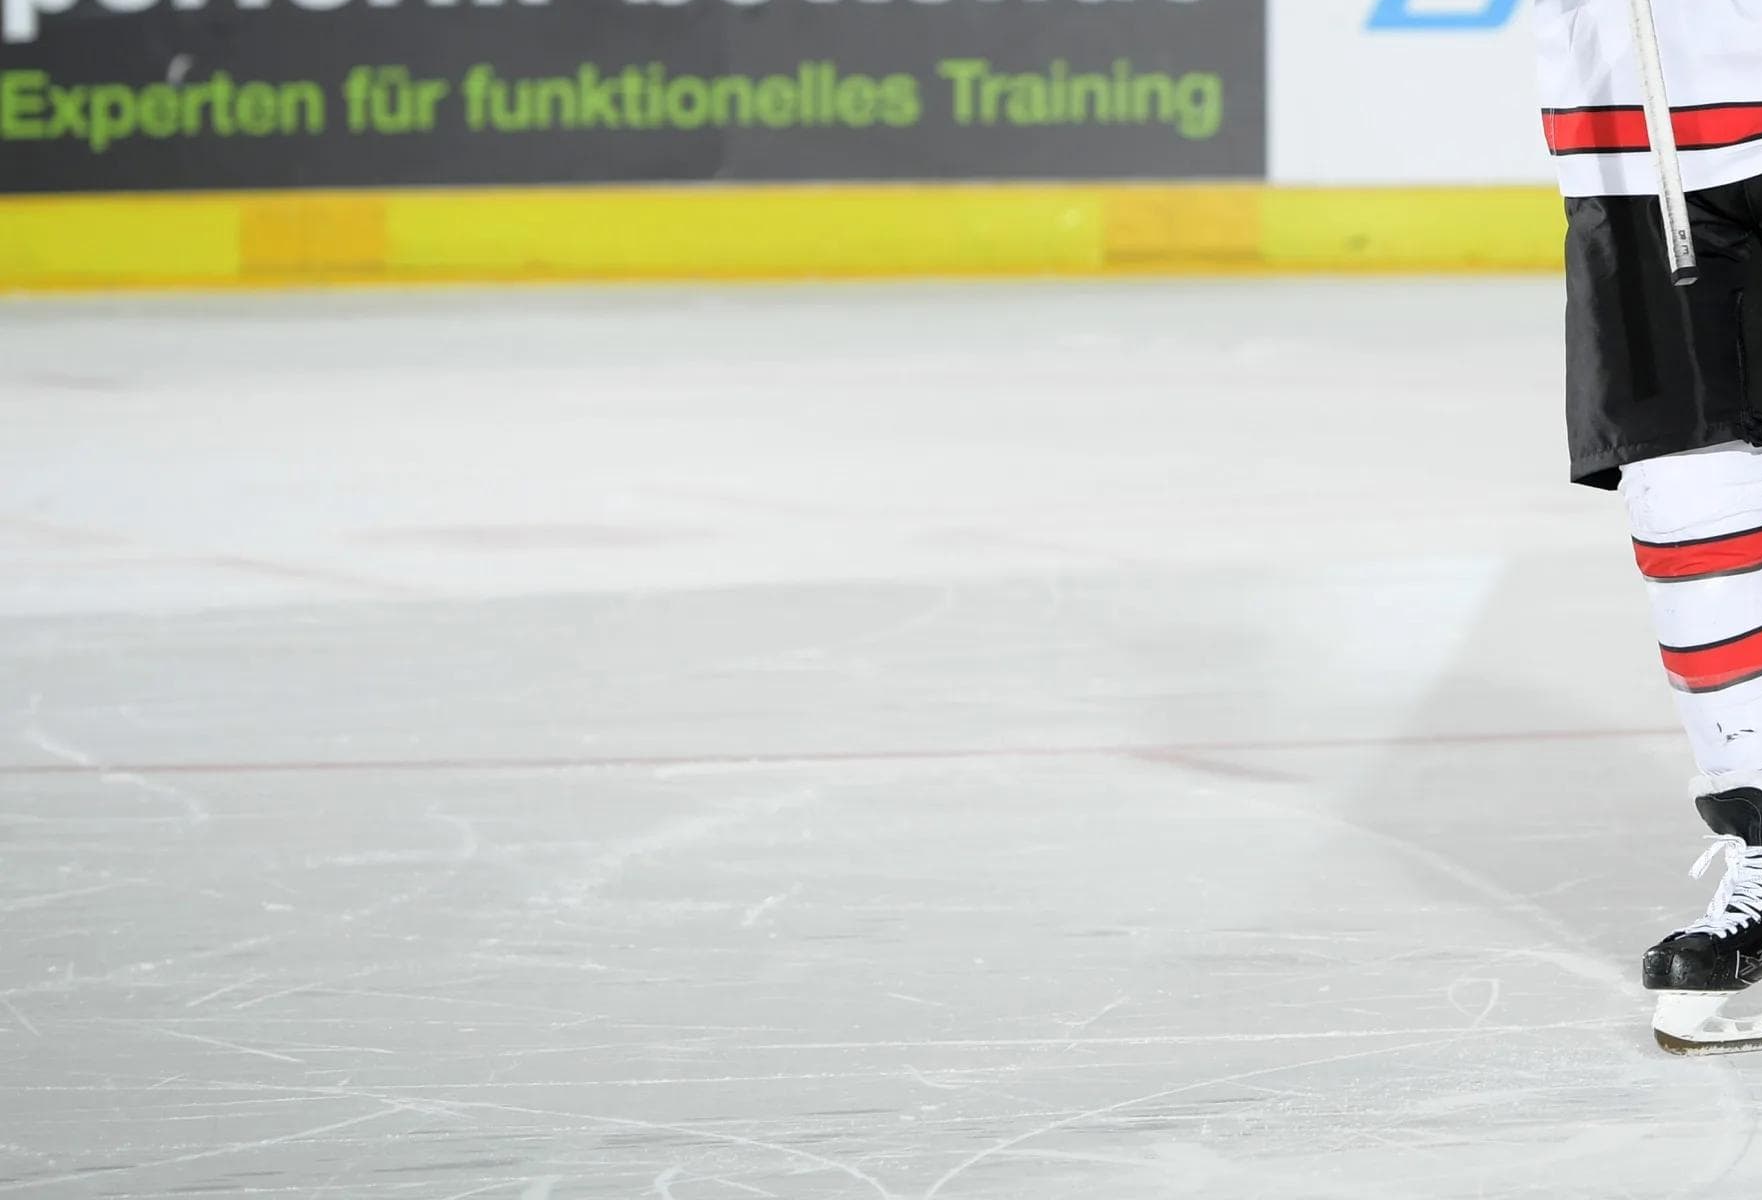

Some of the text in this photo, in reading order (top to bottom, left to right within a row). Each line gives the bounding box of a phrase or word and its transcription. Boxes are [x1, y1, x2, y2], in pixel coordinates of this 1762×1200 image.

[0, 57, 1223, 152] Experten für funktionelles Training
